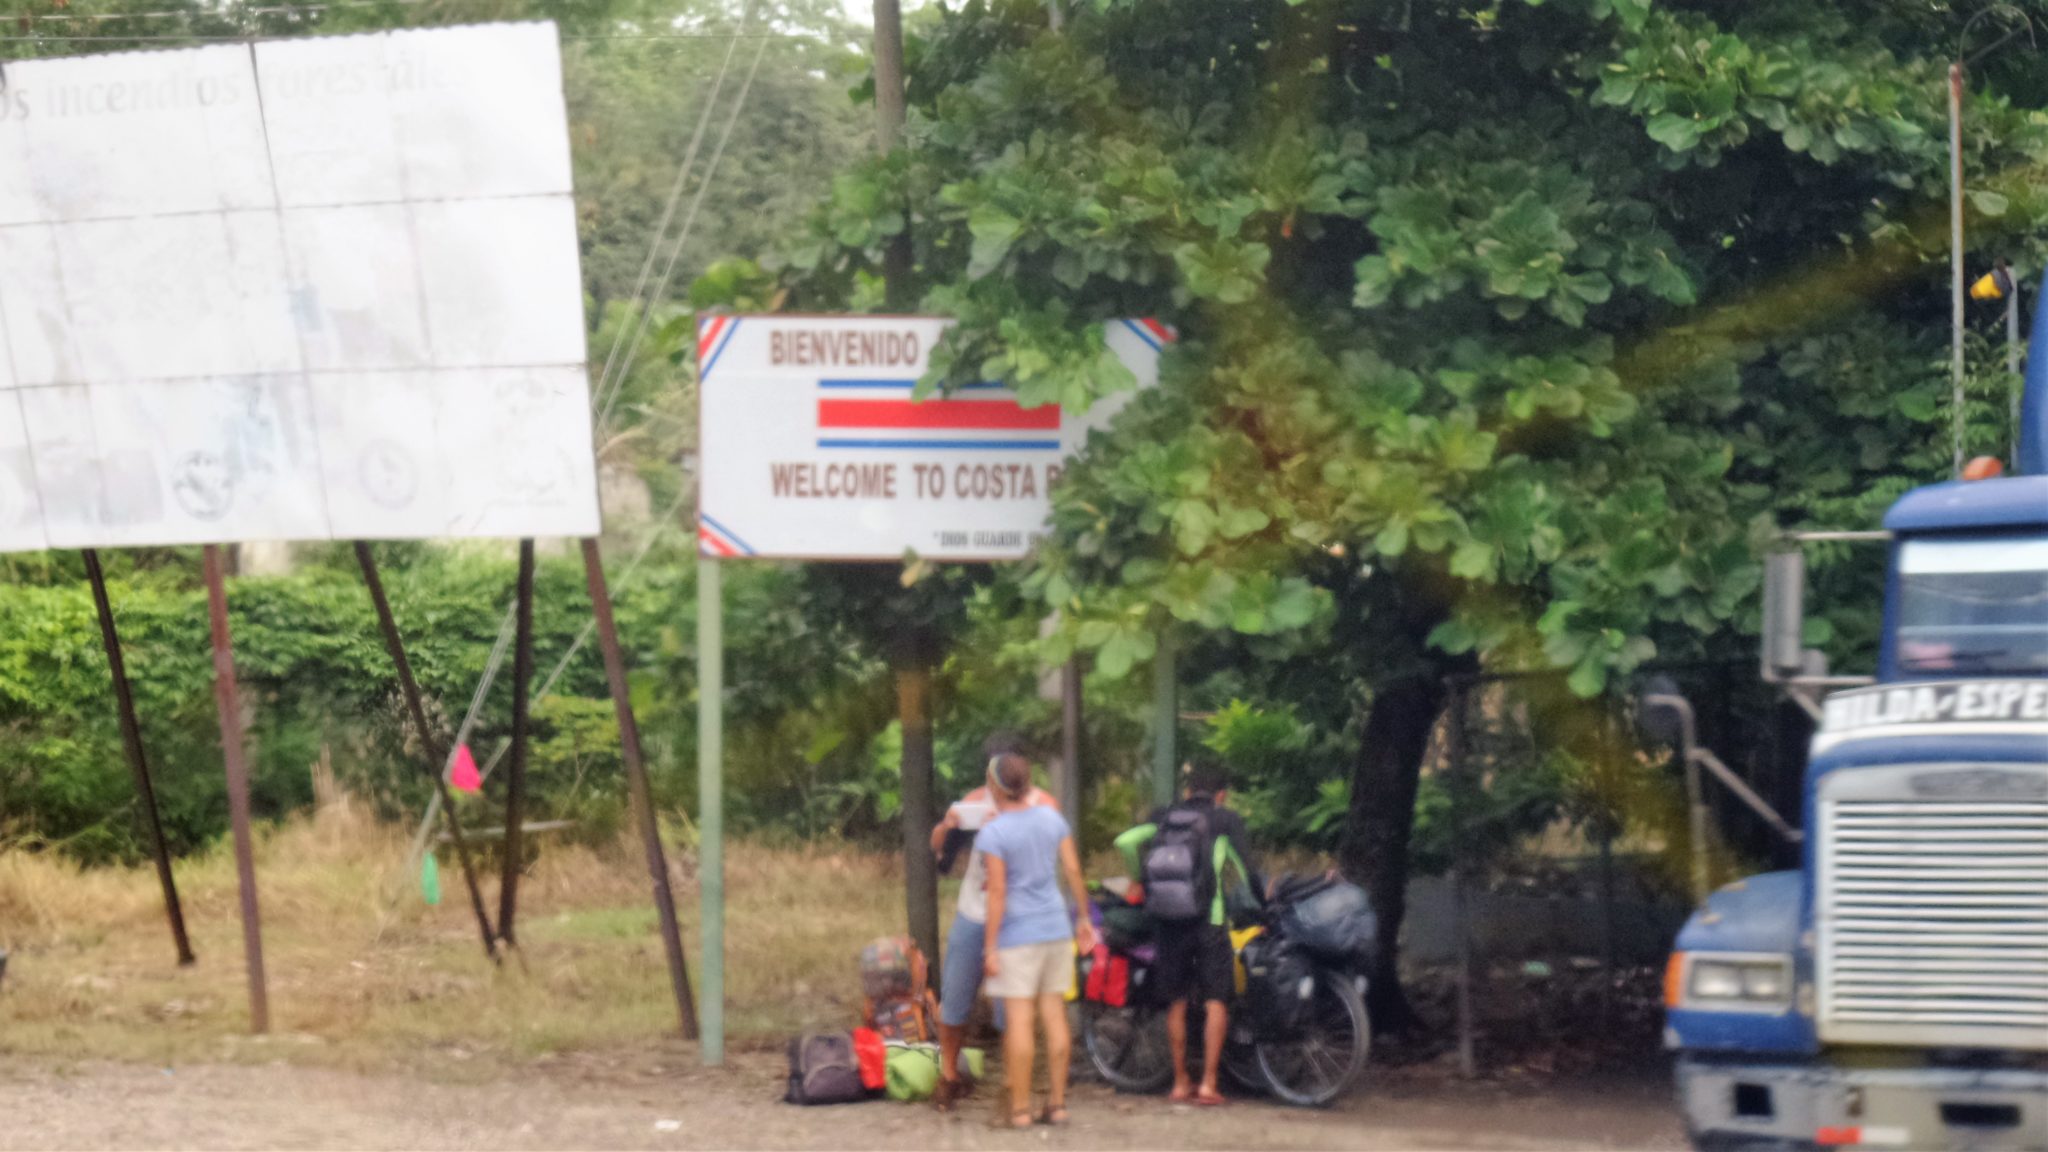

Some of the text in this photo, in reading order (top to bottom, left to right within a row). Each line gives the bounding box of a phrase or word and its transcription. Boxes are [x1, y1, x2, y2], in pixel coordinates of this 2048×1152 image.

[769, 330, 919, 366] BIENVENIDO
[771, 463, 897, 498] WELCOME
[913, 464, 945, 498] TO
[955, 464, 1038, 499] COSTA
